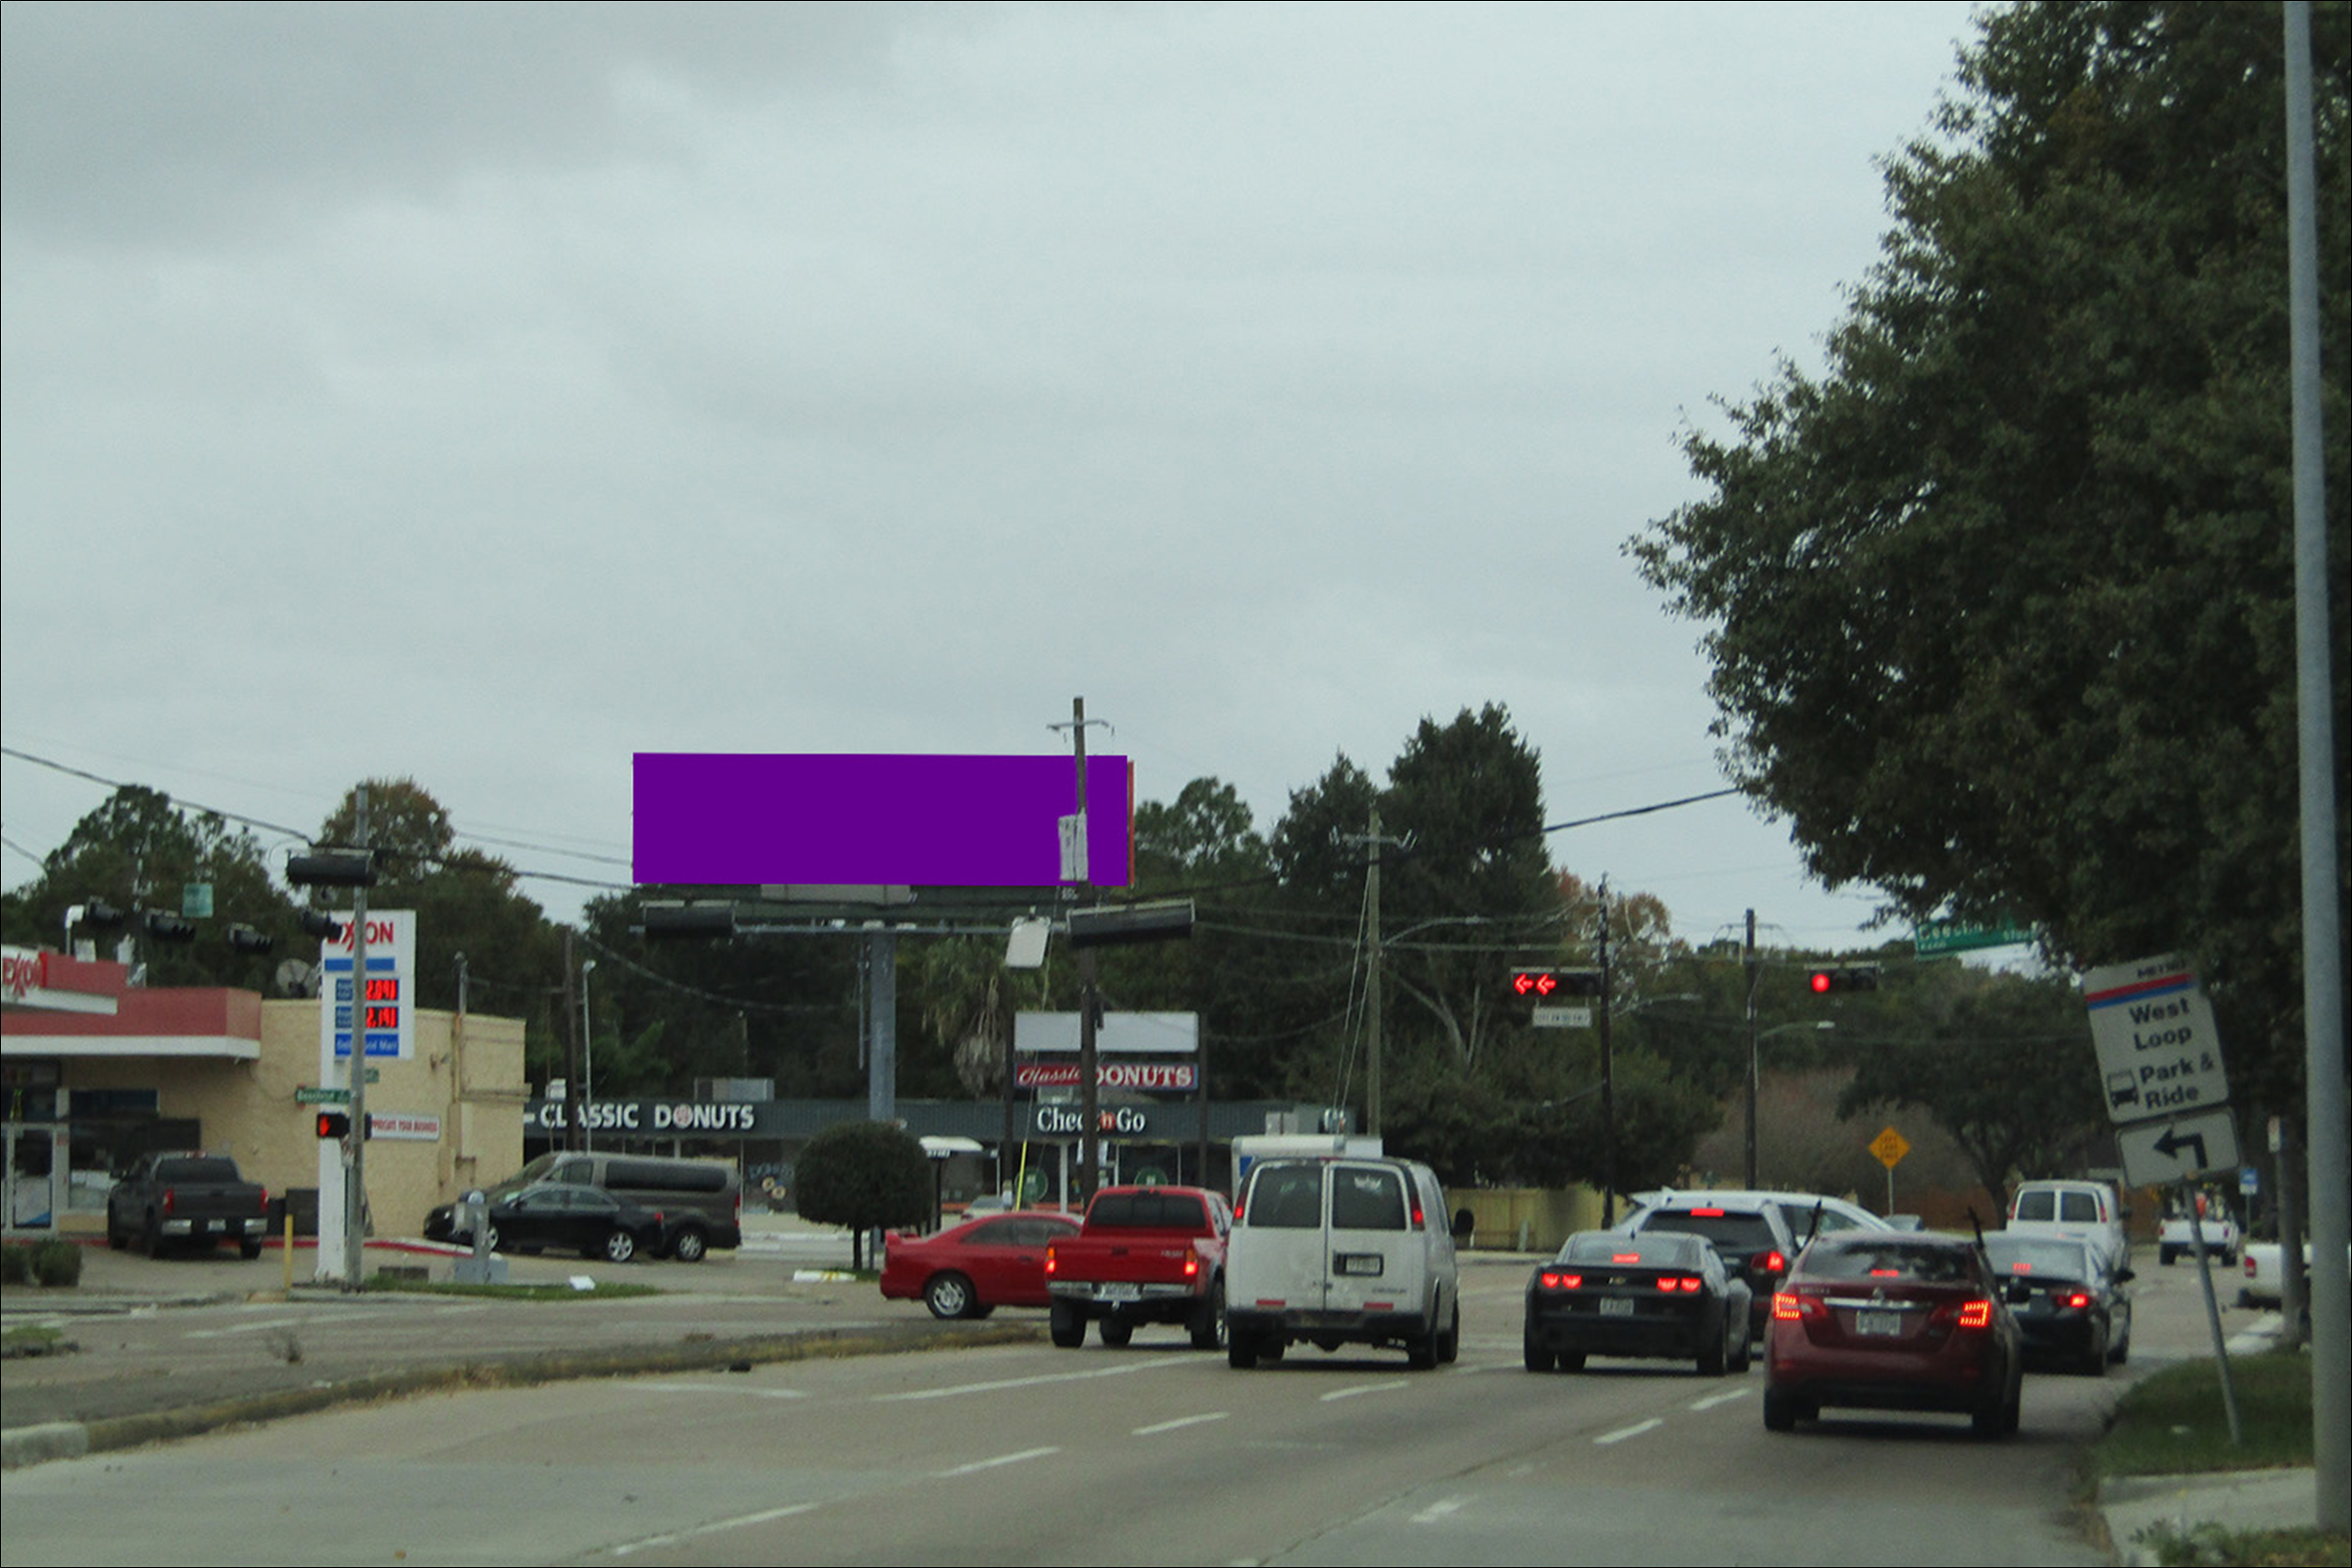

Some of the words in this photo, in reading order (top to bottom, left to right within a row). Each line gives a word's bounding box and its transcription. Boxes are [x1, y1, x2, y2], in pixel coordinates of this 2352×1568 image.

[327, 919, 394, 952] XON
[2129, 998, 2189, 1024] West
[2133, 1027, 2192, 1052] Loop
[2140, 1057, 2194, 1084] Park
[2200, 1053, 2214, 1072] &
[2144, 1085, 2199, 1109] Ride
[655, 1103, 755, 1129] DONUTS
[1116, 1107, 1146, 1133] Go
